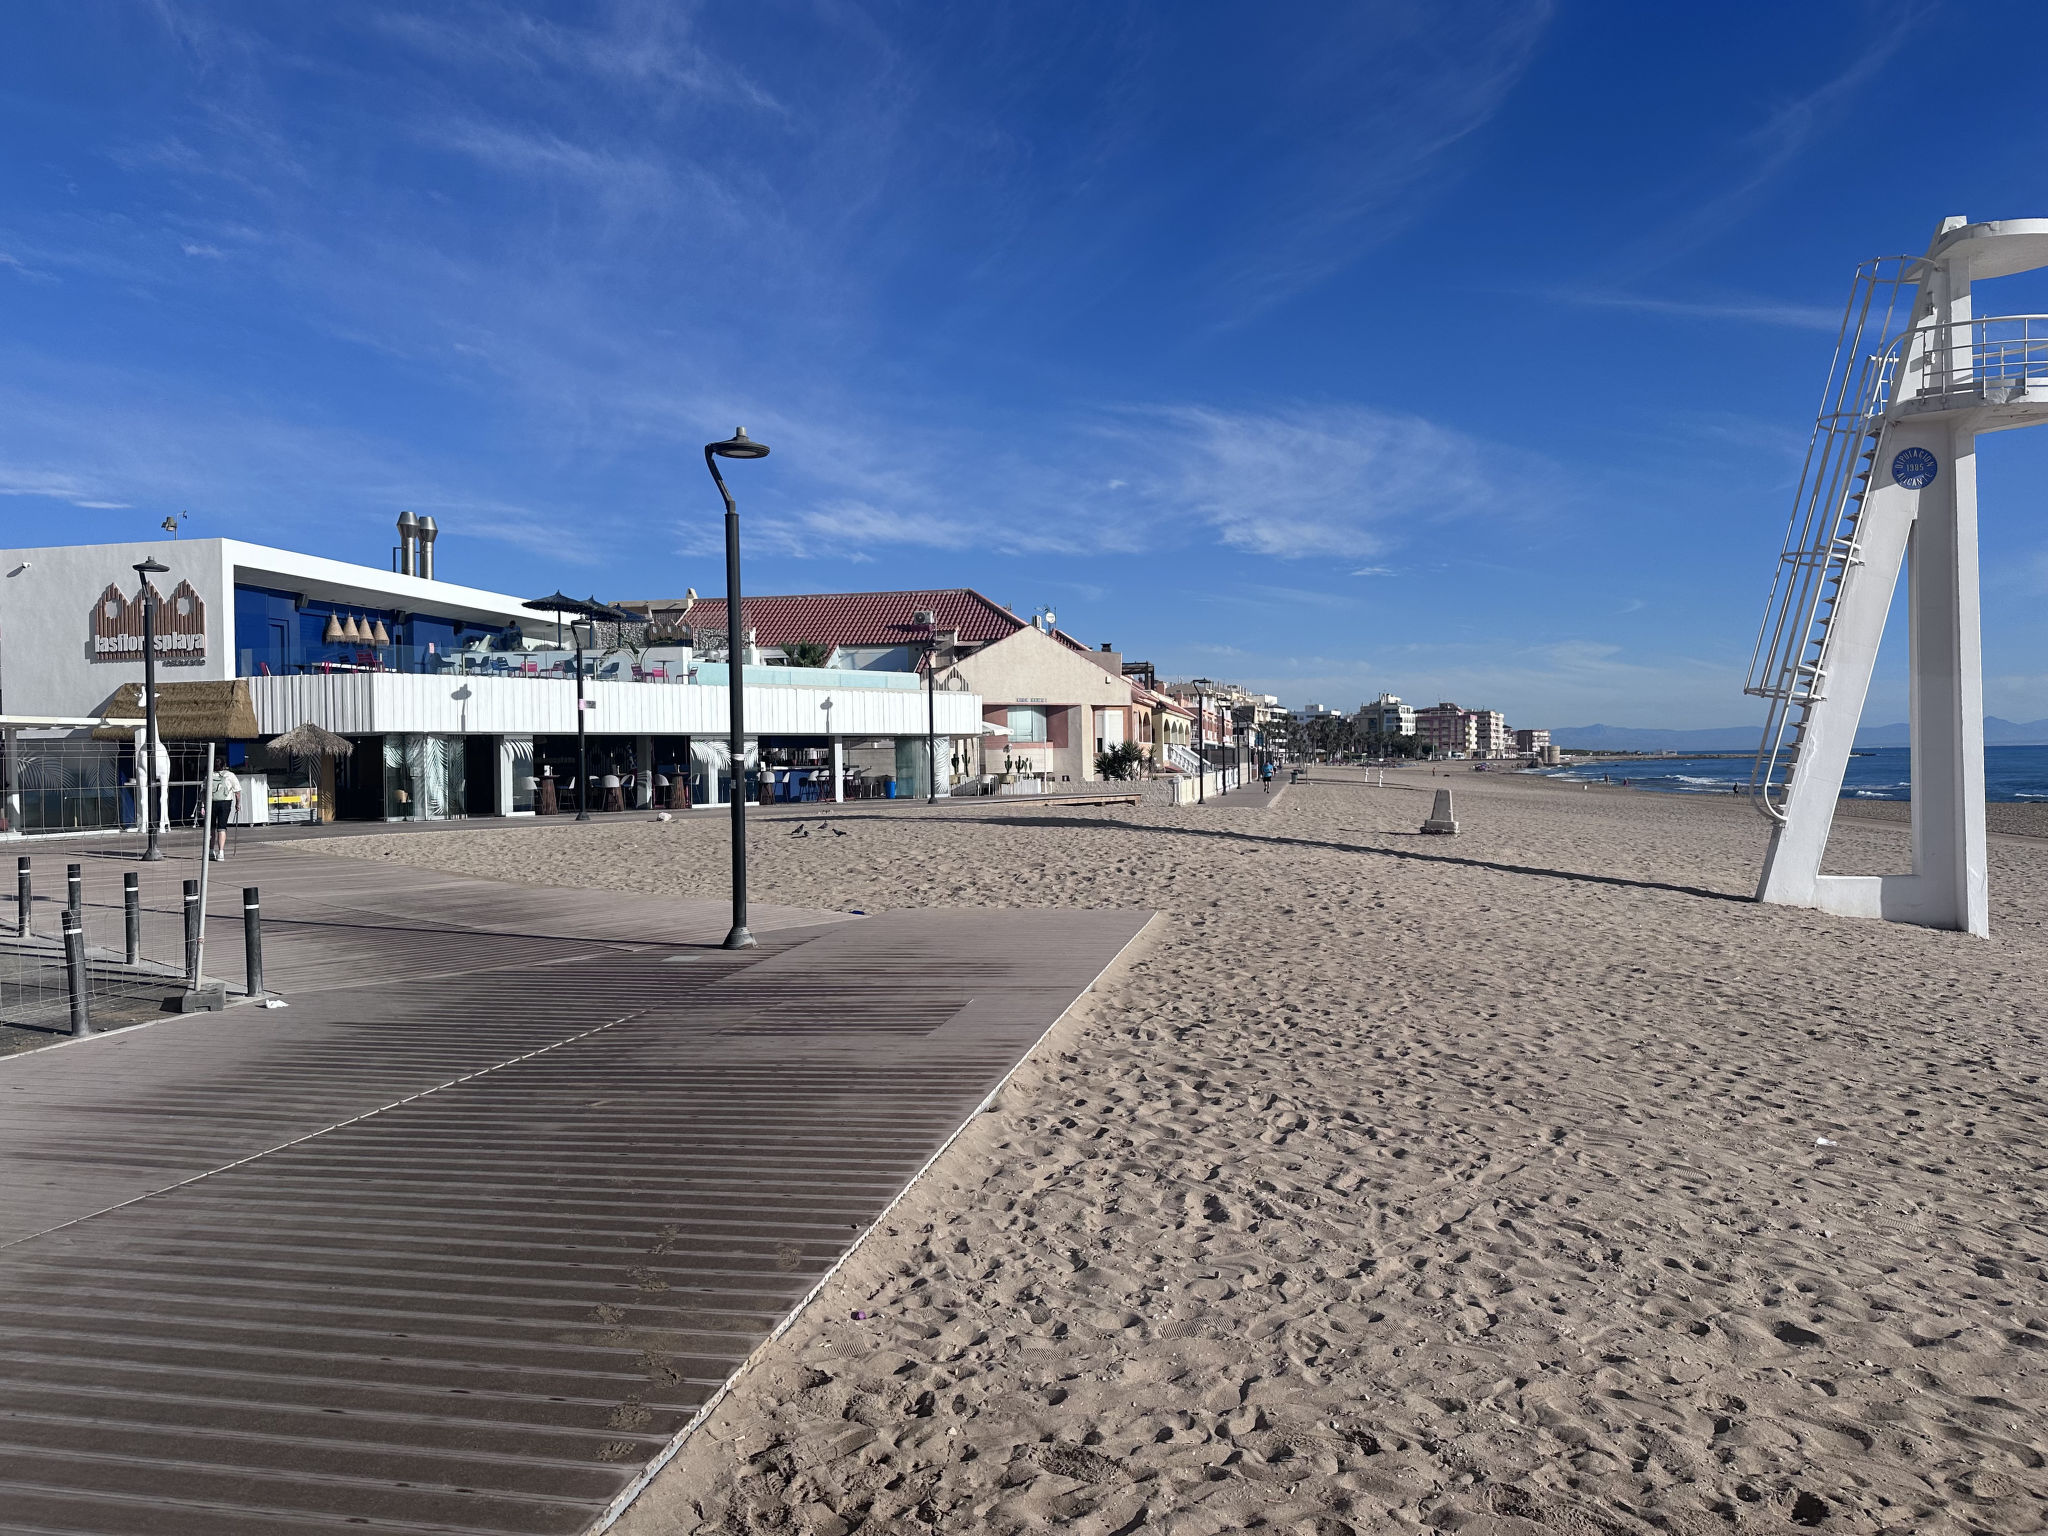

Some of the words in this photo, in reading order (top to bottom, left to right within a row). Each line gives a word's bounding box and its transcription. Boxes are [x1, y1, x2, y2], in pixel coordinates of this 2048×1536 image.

[1906, 462, 1924, 471] 1985
[1896, 472, 1933, 486] ALICANTE
[95, 631, 204, 652] lasflorsplaya
